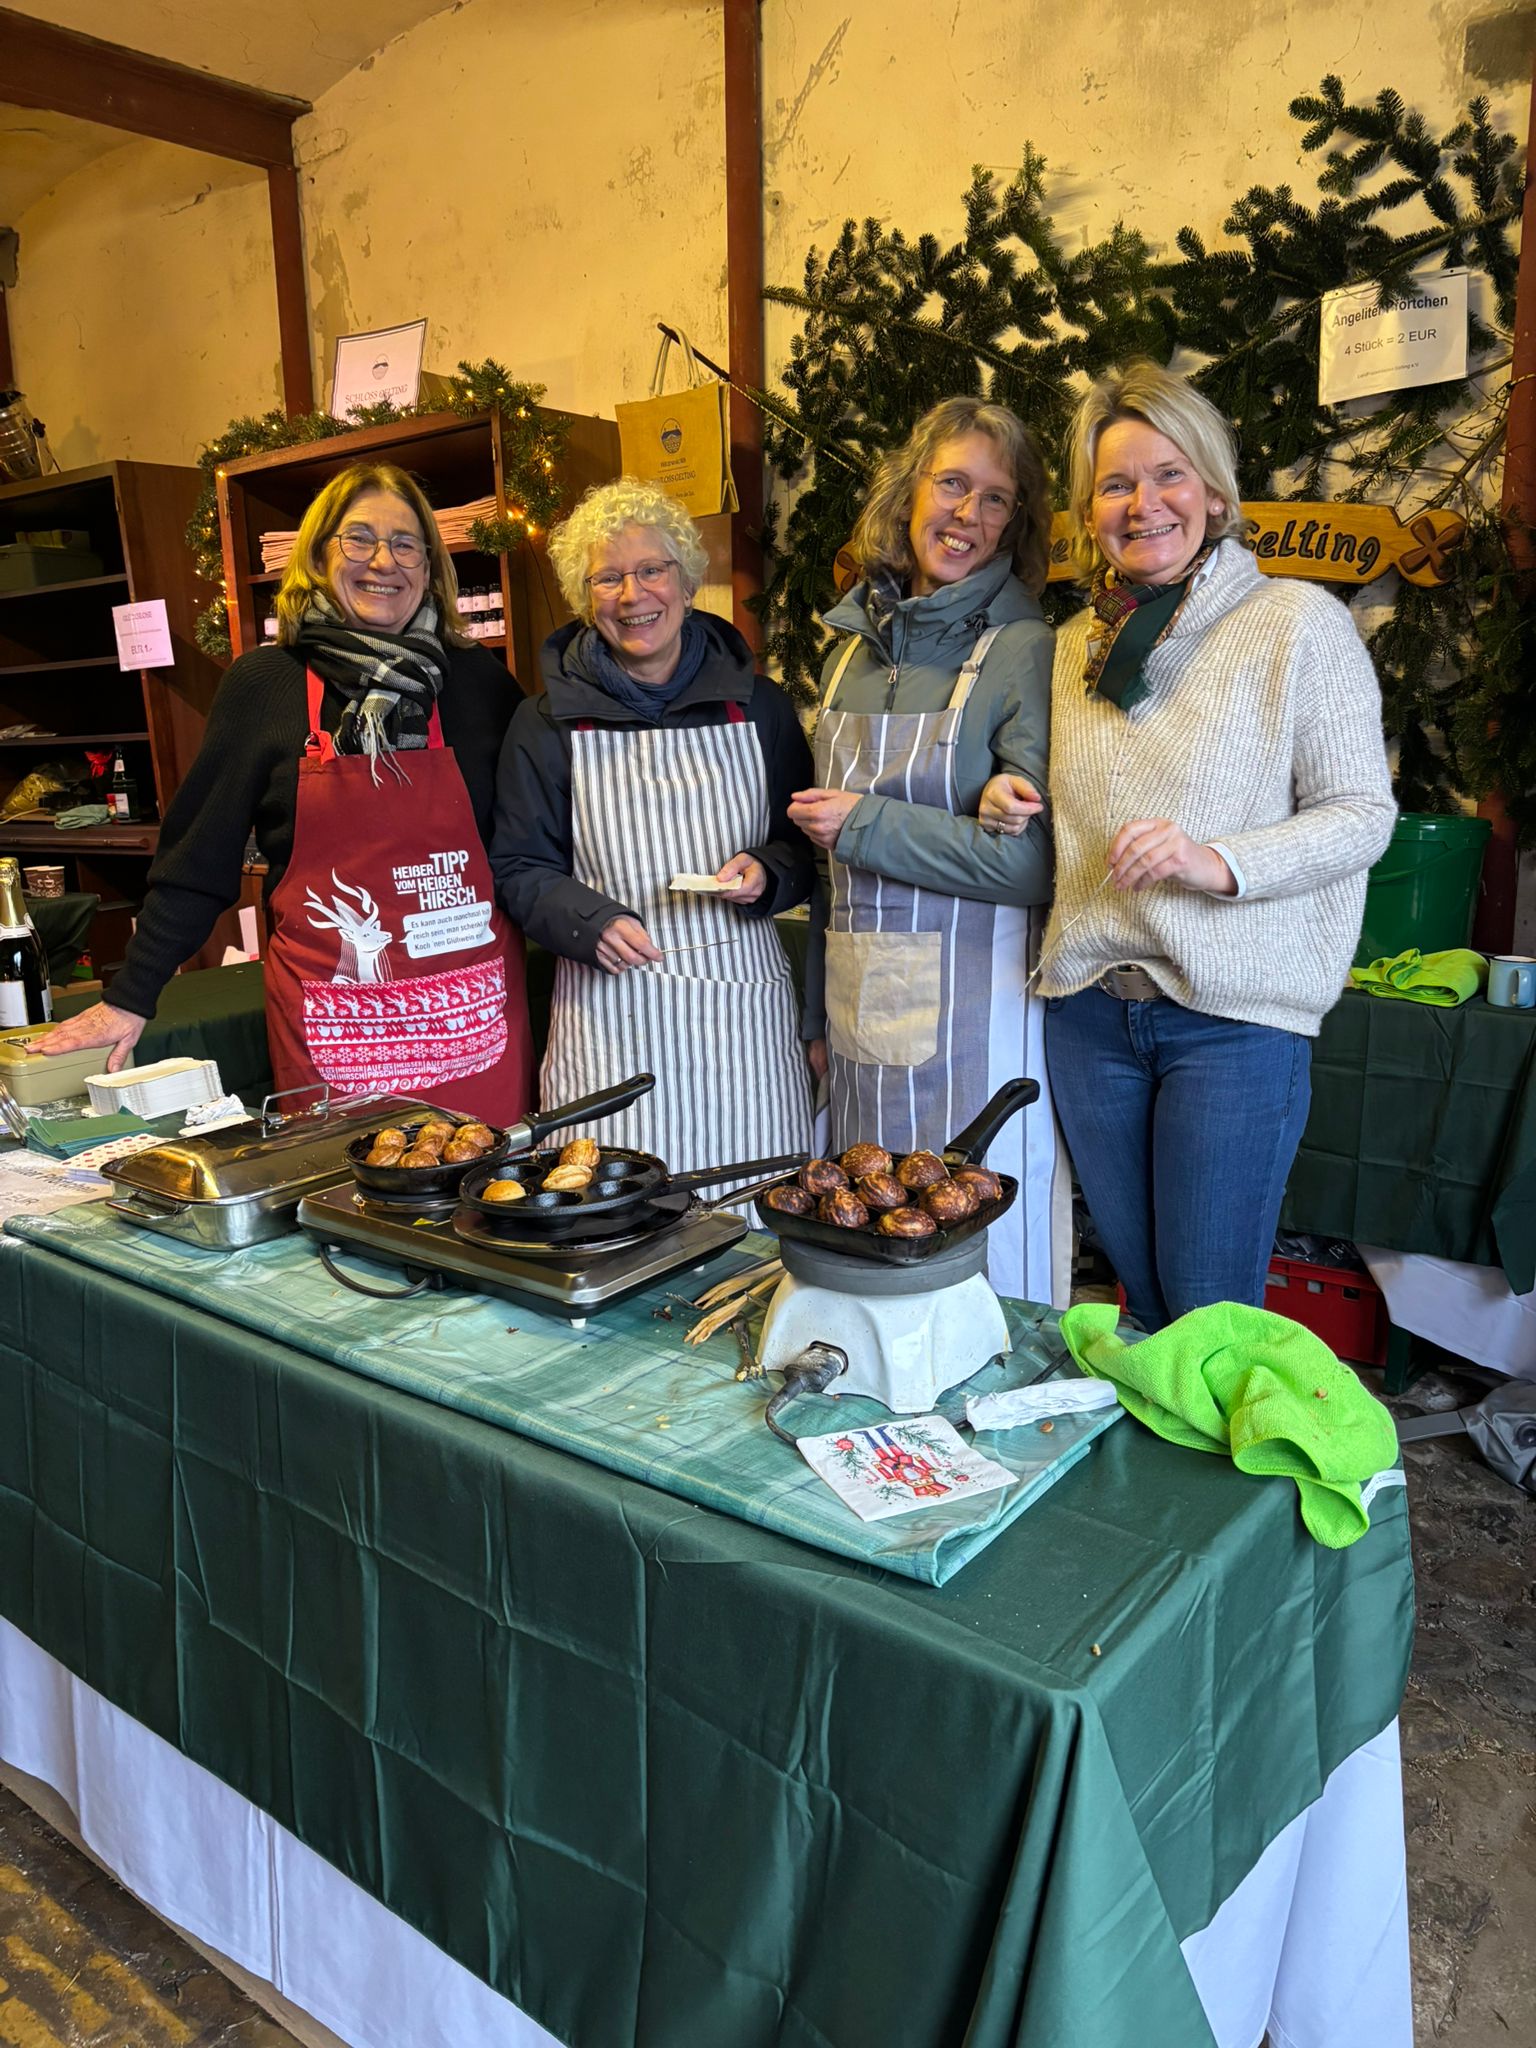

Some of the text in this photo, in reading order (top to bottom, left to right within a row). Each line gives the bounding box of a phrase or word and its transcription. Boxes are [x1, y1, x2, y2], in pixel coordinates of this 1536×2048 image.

[1344, 345, 1351, 356] 4
[1354, 338, 1384, 354] Stück
[1397, 332, 1405, 344] 2
[1408, 328, 1437, 342] EUR
[345, 391, 378, 405] SCHLOSS
[392, 850, 469, 879] HEIßER TIPP
[395, 873, 462, 892] VOM HEIßEN
[419, 885, 477, 911] HIRSCH
[411, 921, 419, 929] Es
[420, 919, 436, 927] kann
[437, 915, 452, 925] auch
[453, 909, 481, 921] manchmal
[413, 931, 430, 940] reich
[446, 926, 460, 934] man
[414, 942, 431, 951] Koch
[367, 1063, 382, 1072] AUF
[367, 1069, 394, 1079] PIRSCH
[397, 1067, 424, 1076] HIRSCH
[339, 1072, 365, 1081] HIRSCH
